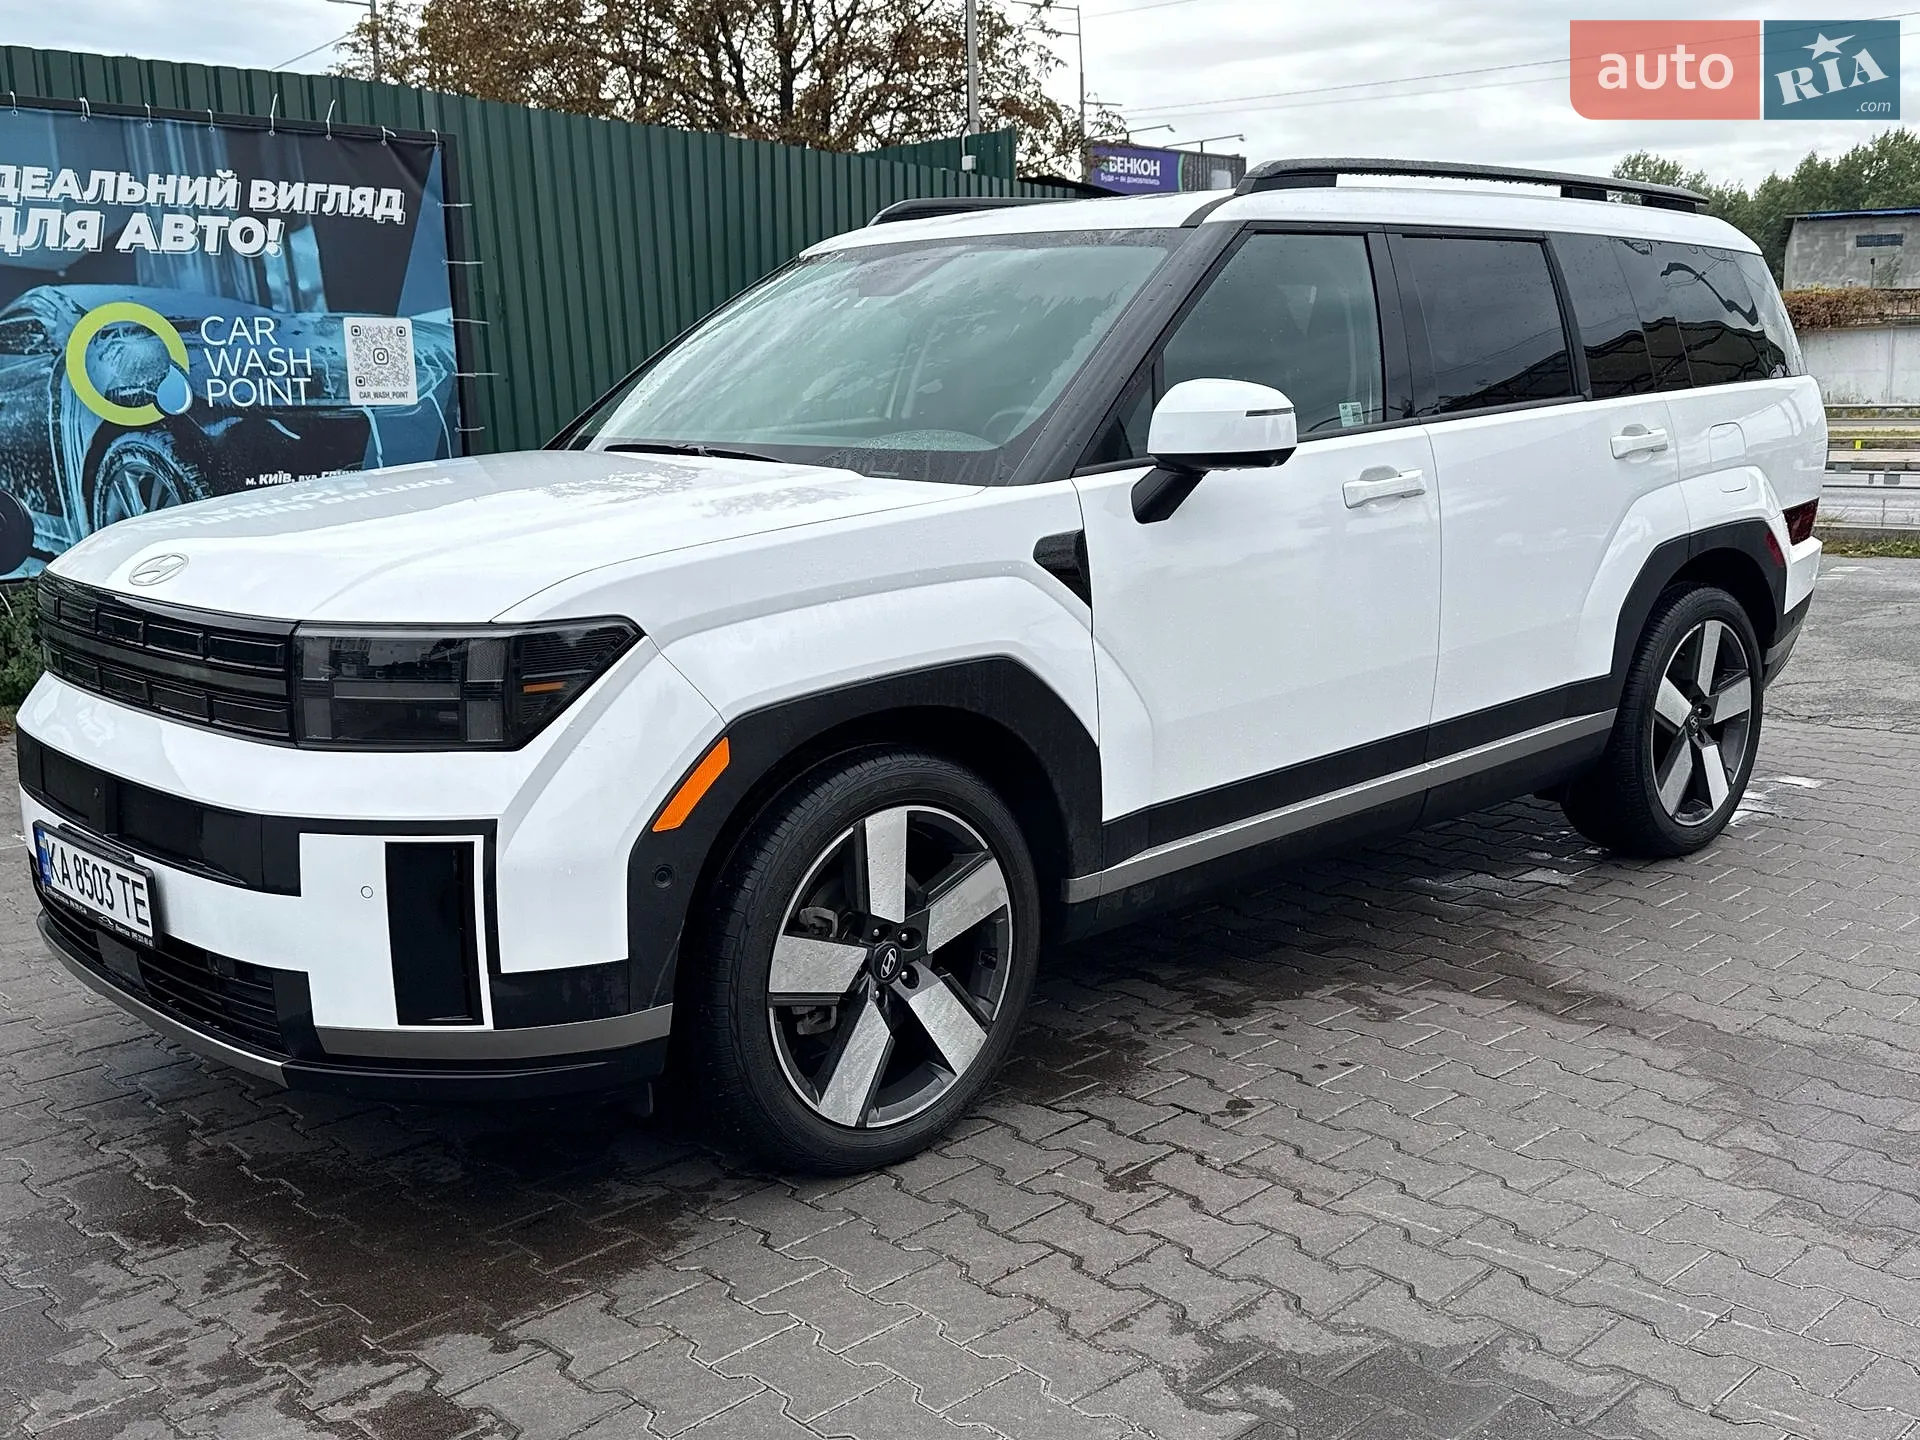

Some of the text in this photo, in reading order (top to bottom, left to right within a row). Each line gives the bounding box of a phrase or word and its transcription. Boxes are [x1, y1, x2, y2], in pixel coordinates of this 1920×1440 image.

[1109, 156, 1161, 176] БЕНКОН
[249, 179, 405, 225] ВИГЛЯД
[115, 212, 285, 258] АВТО!
[200, 316, 278, 346] CAR
[204, 347, 312, 377] WASH
[206, 377, 312, 408] POINT
[45, 838, 74, 891] KA
[73, 855, 115, 911] 8503
[115, 872, 150, 928] TE
